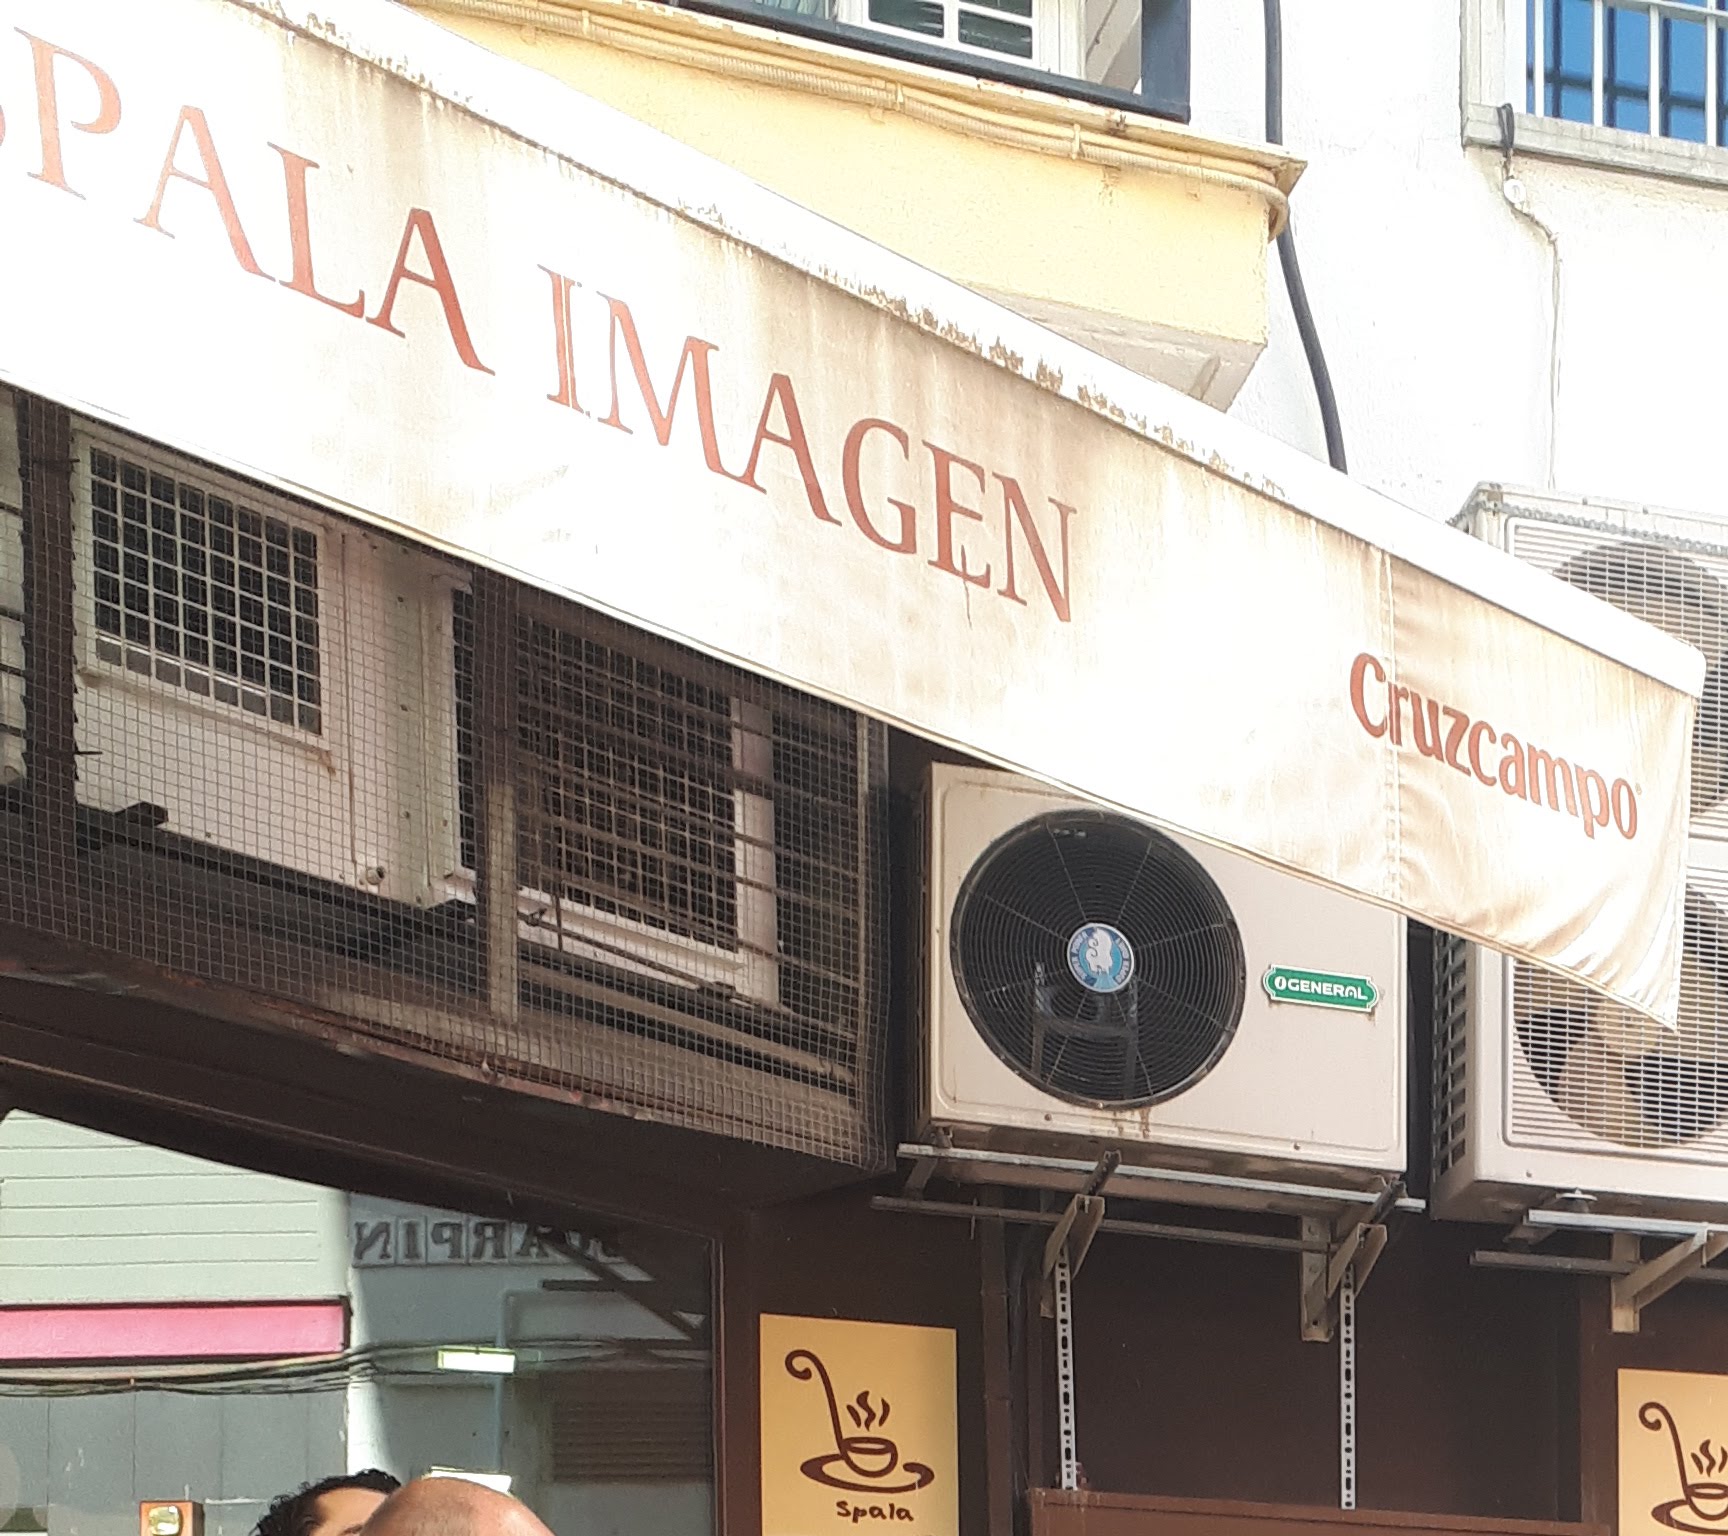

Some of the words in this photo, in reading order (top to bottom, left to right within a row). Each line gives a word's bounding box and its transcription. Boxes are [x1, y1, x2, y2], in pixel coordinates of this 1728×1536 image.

[0, 27, 496, 377] PALA
[537, 264, 1077, 623] IMAGEN
[1350, 652, 1638, 840] Cruzcampo
[836, 1500, 914, 1523] Spala
